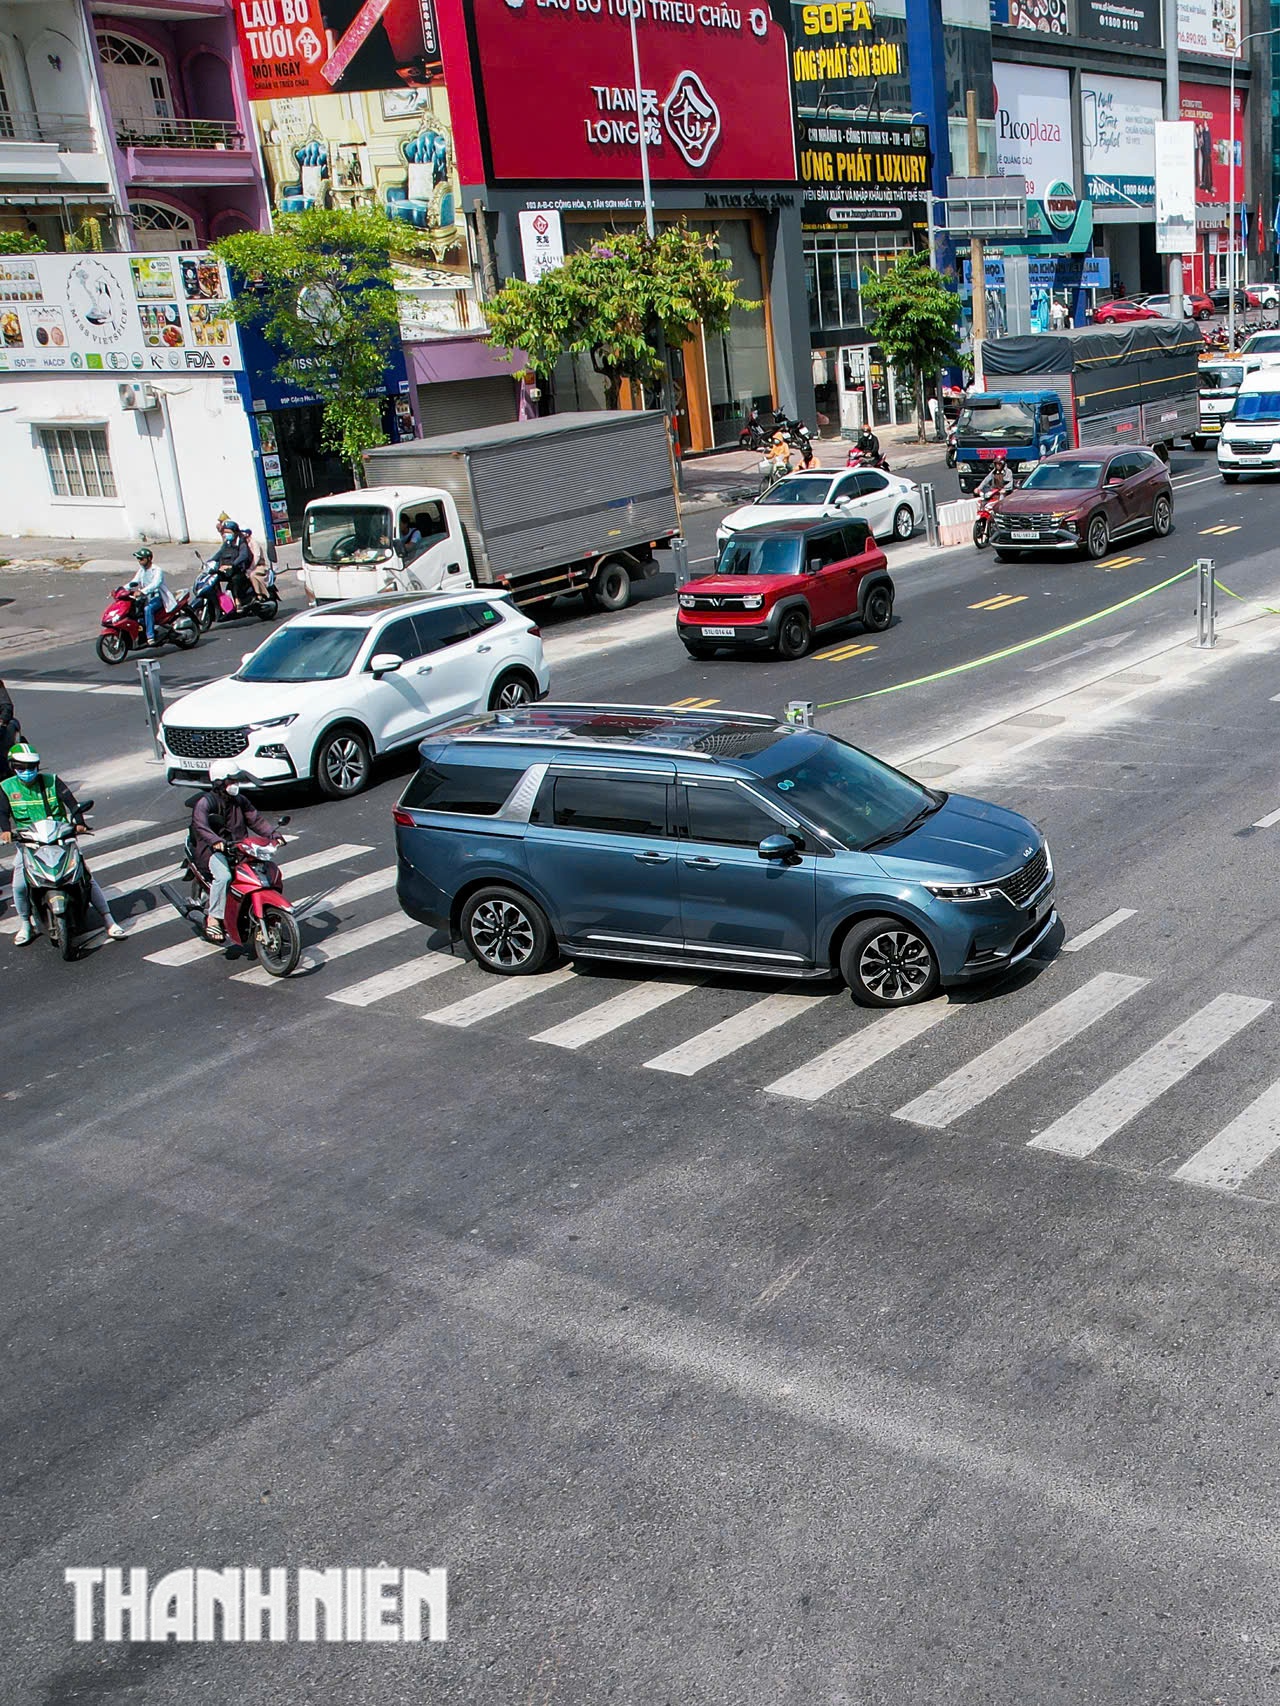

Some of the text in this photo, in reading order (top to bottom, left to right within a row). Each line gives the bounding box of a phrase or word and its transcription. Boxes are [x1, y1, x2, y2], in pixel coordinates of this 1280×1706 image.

[699, 2, 741, 29] CHÂU
[802, 1, 872, 35] SOFA
[246, 25, 294, 59] TƯƠI
[793, 37, 898, 82] ƯNG PHÁT SÀI GÒN
[591, 86, 637, 111] TIAN
[584, 119, 640, 143] LONG
[999, 109, 1061, 147] Picoplaza
[801, 147, 926, 183] ƯNG PHÁT LUXURY
[43, 359, 65, 367] HACCP
[185, 351, 215, 368] FDA
